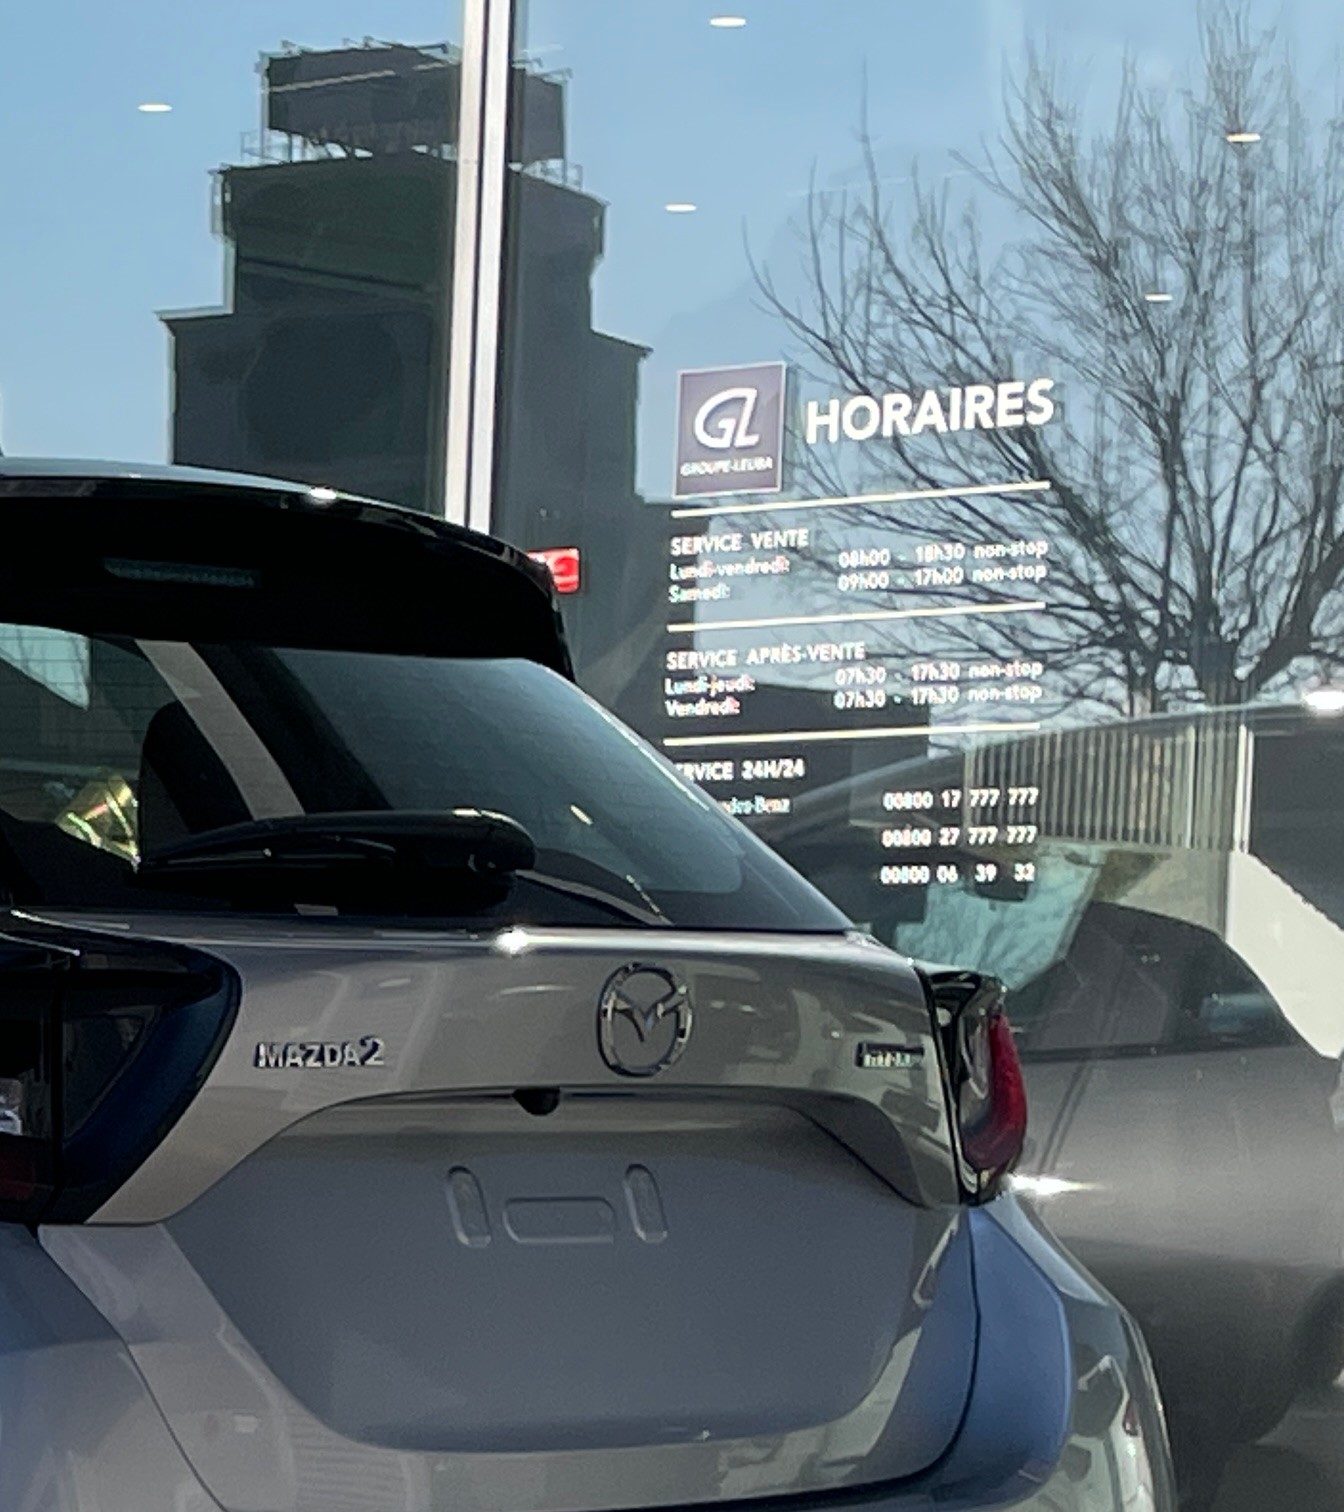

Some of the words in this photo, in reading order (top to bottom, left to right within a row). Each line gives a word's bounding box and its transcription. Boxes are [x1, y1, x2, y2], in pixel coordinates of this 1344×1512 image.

[694, 387, 760, 448] GL
[806, 378, 1055, 444] HORAIRES
[670, 533, 742, 556] SERVICE
[751, 528, 809, 550] VENTE
[972, 540, 1049, 560] non-stop
[914, 566, 964, 587] 17h00
[972, 563, 1048, 583] non-stop
[665, 648, 738, 671] SERVICE
[745, 641, 867, 665] APRÈS-VENTE
[834, 665, 887, 686] 07h30
[911, 661, 961, 682] 17h30
[967, 659, 1044, 680] non-stop
[833, 689, 887, 710] 07h30
[967, 683, 1044, 704] non-stop
[741, 758, 805, 780] 24H/24
[941, 788, 962, 808] 17
[968, 787, 1000, 807] 777
[1007, 786, 1039, 806] 777
[938, 826, 961, 846] 27
[967, 825, 999, 845] 777
[1006, 824, 1038, 844] 777
[253, 1035, 386, 1068] MAZDA2
